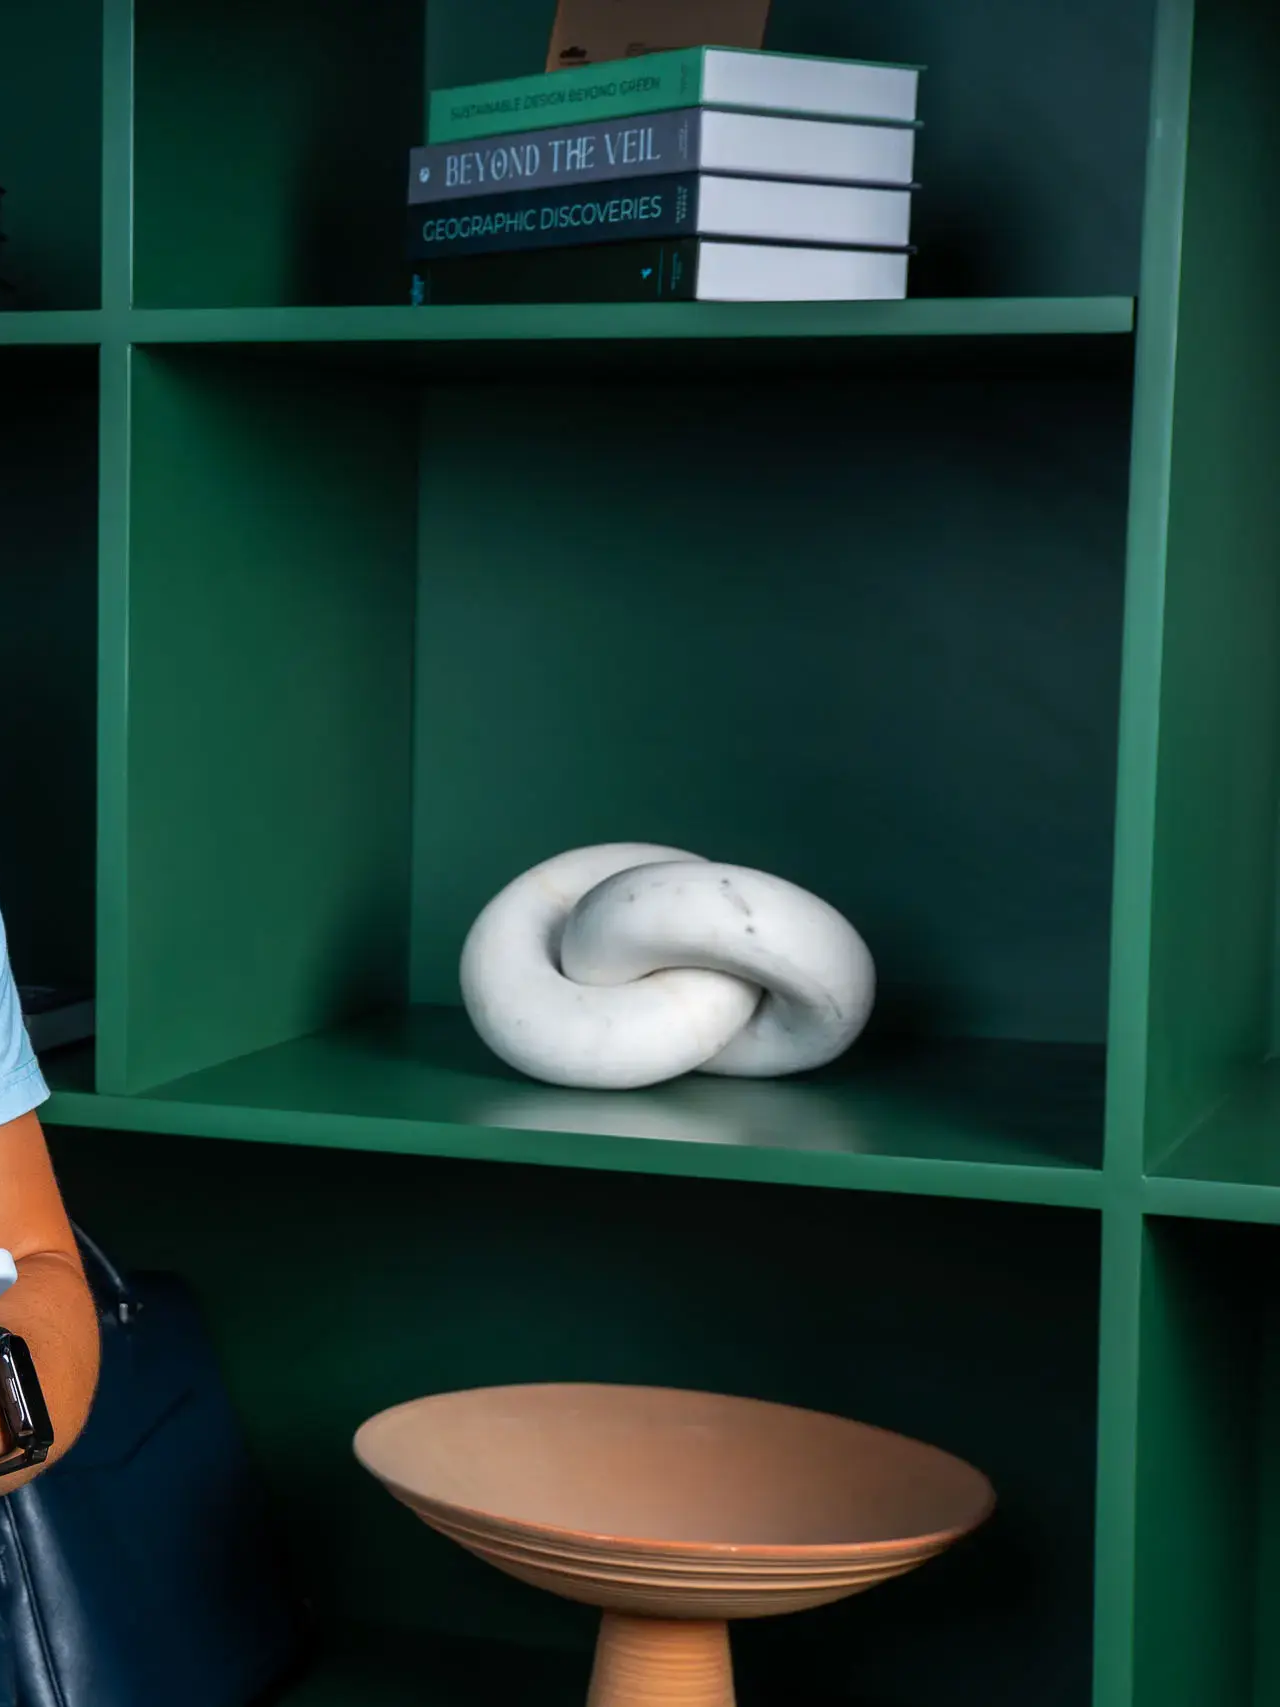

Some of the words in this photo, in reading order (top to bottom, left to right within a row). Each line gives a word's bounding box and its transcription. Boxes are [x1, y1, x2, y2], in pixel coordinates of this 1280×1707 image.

[450, 97, 521, 121] SUSTAINABLE
[523, 92, 565, 110] DESIGN
[568, 84, 616, 103] BEYOND
[619, 76, 661, 96] GREEN
[445, 144, 540, 187] BEYOND
[548, 136, 596, 173] THE
[604, 127, 661, 165] VEIL
[422, 208, 537, 242] GEOGRAPHIC
[540, 195, 662, 231] DISCOVERIES
